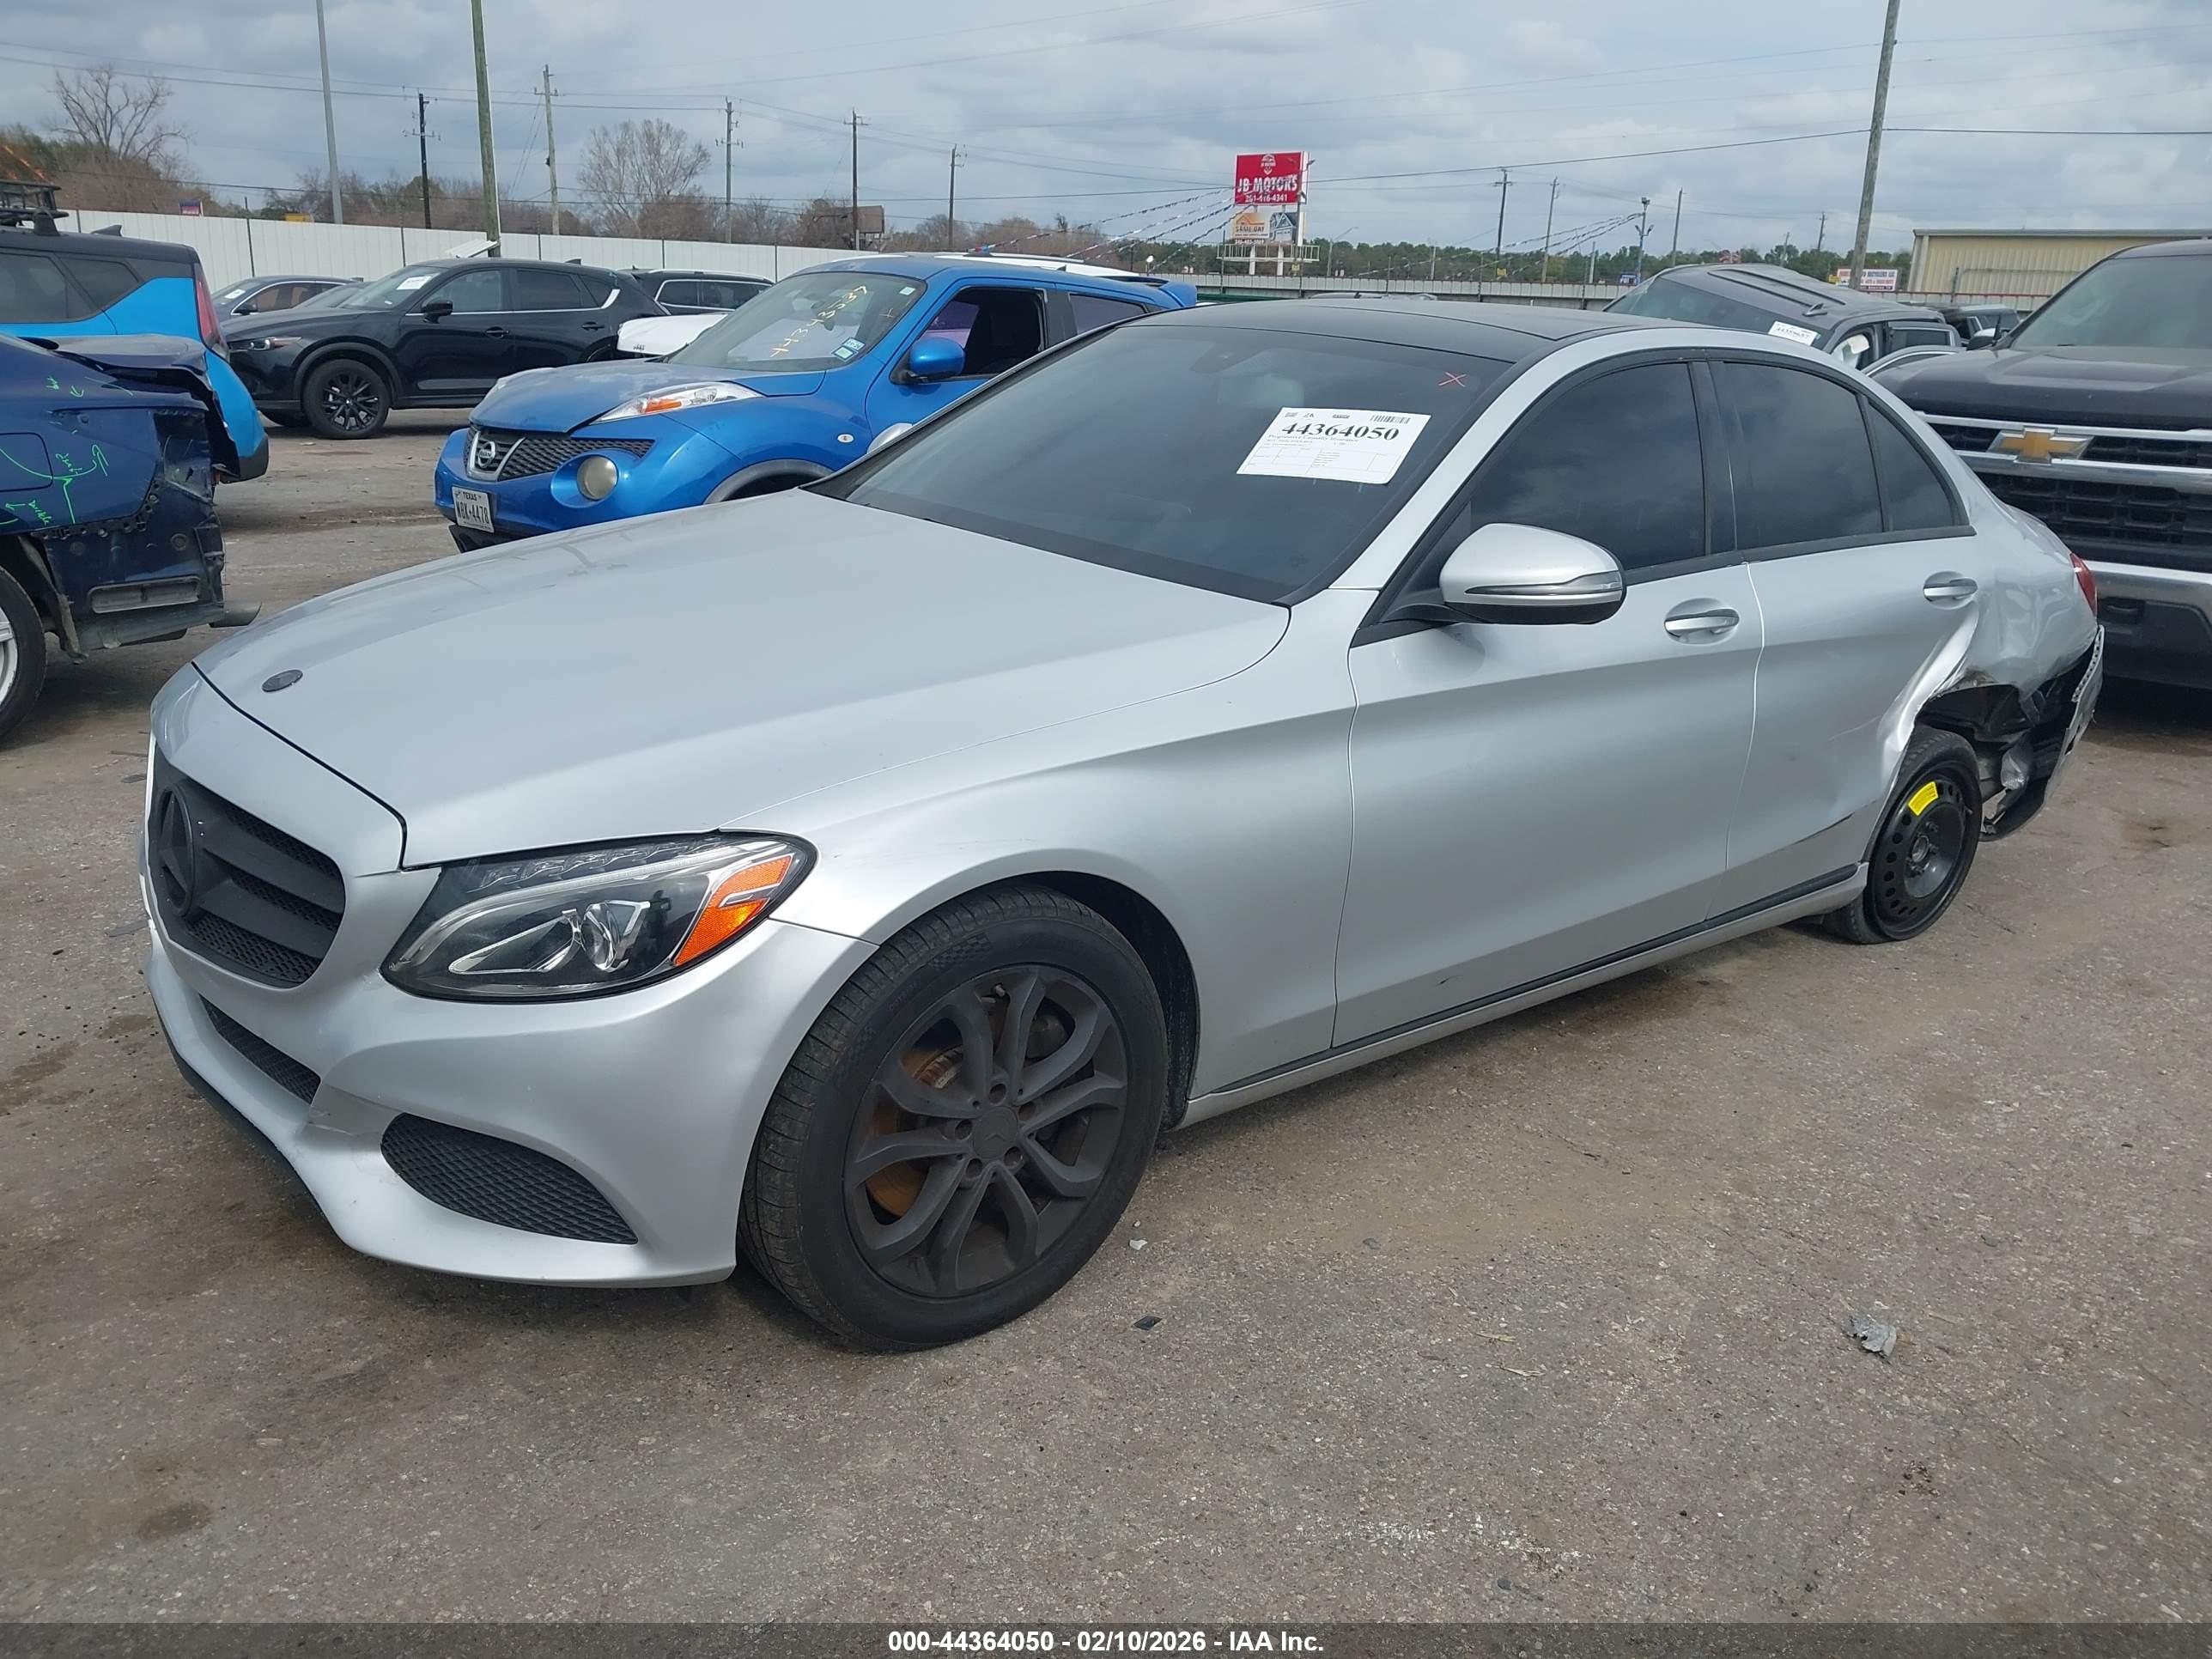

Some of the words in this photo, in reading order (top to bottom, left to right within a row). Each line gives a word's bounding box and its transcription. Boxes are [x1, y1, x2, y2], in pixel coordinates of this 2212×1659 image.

[1237, 178, 1250, 193] JB
[1254, 174, 1298, 193] MOTORS
[1282, 422, 1400, 441] 44364050
[462, 491, 477, 501] TEXAS
